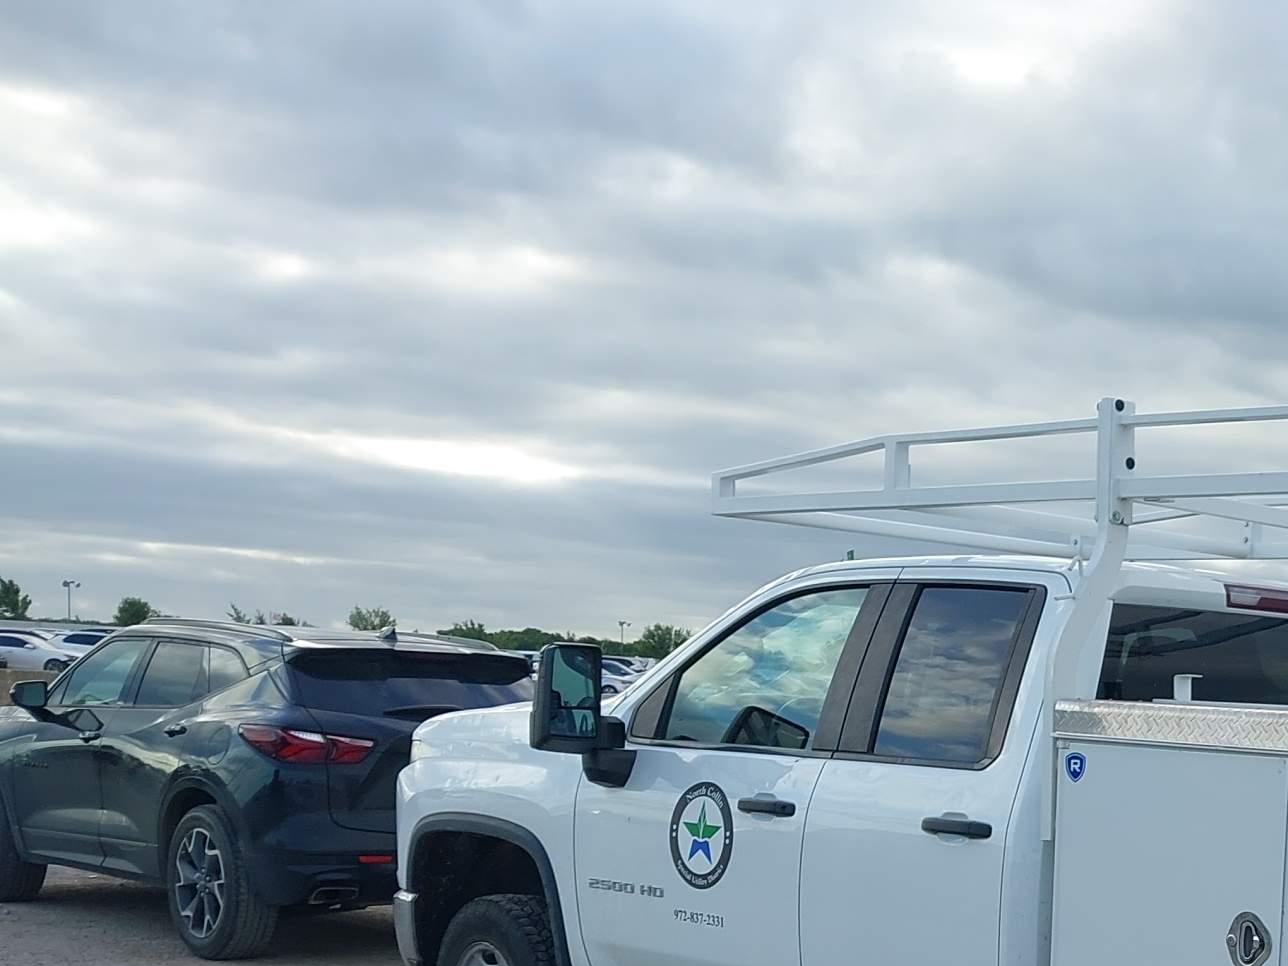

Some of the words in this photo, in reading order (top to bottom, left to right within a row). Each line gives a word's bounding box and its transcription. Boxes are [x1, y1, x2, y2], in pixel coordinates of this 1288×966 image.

[1070, 759, 1081, 773] R
[686, 785, 707, 802] North
[707, 786, 724, 808] Collin
[587, 878, 636, 895] 2500
[639, 884, 665, 898] HD
[673, 909, 724, 928] 972-837-2331
